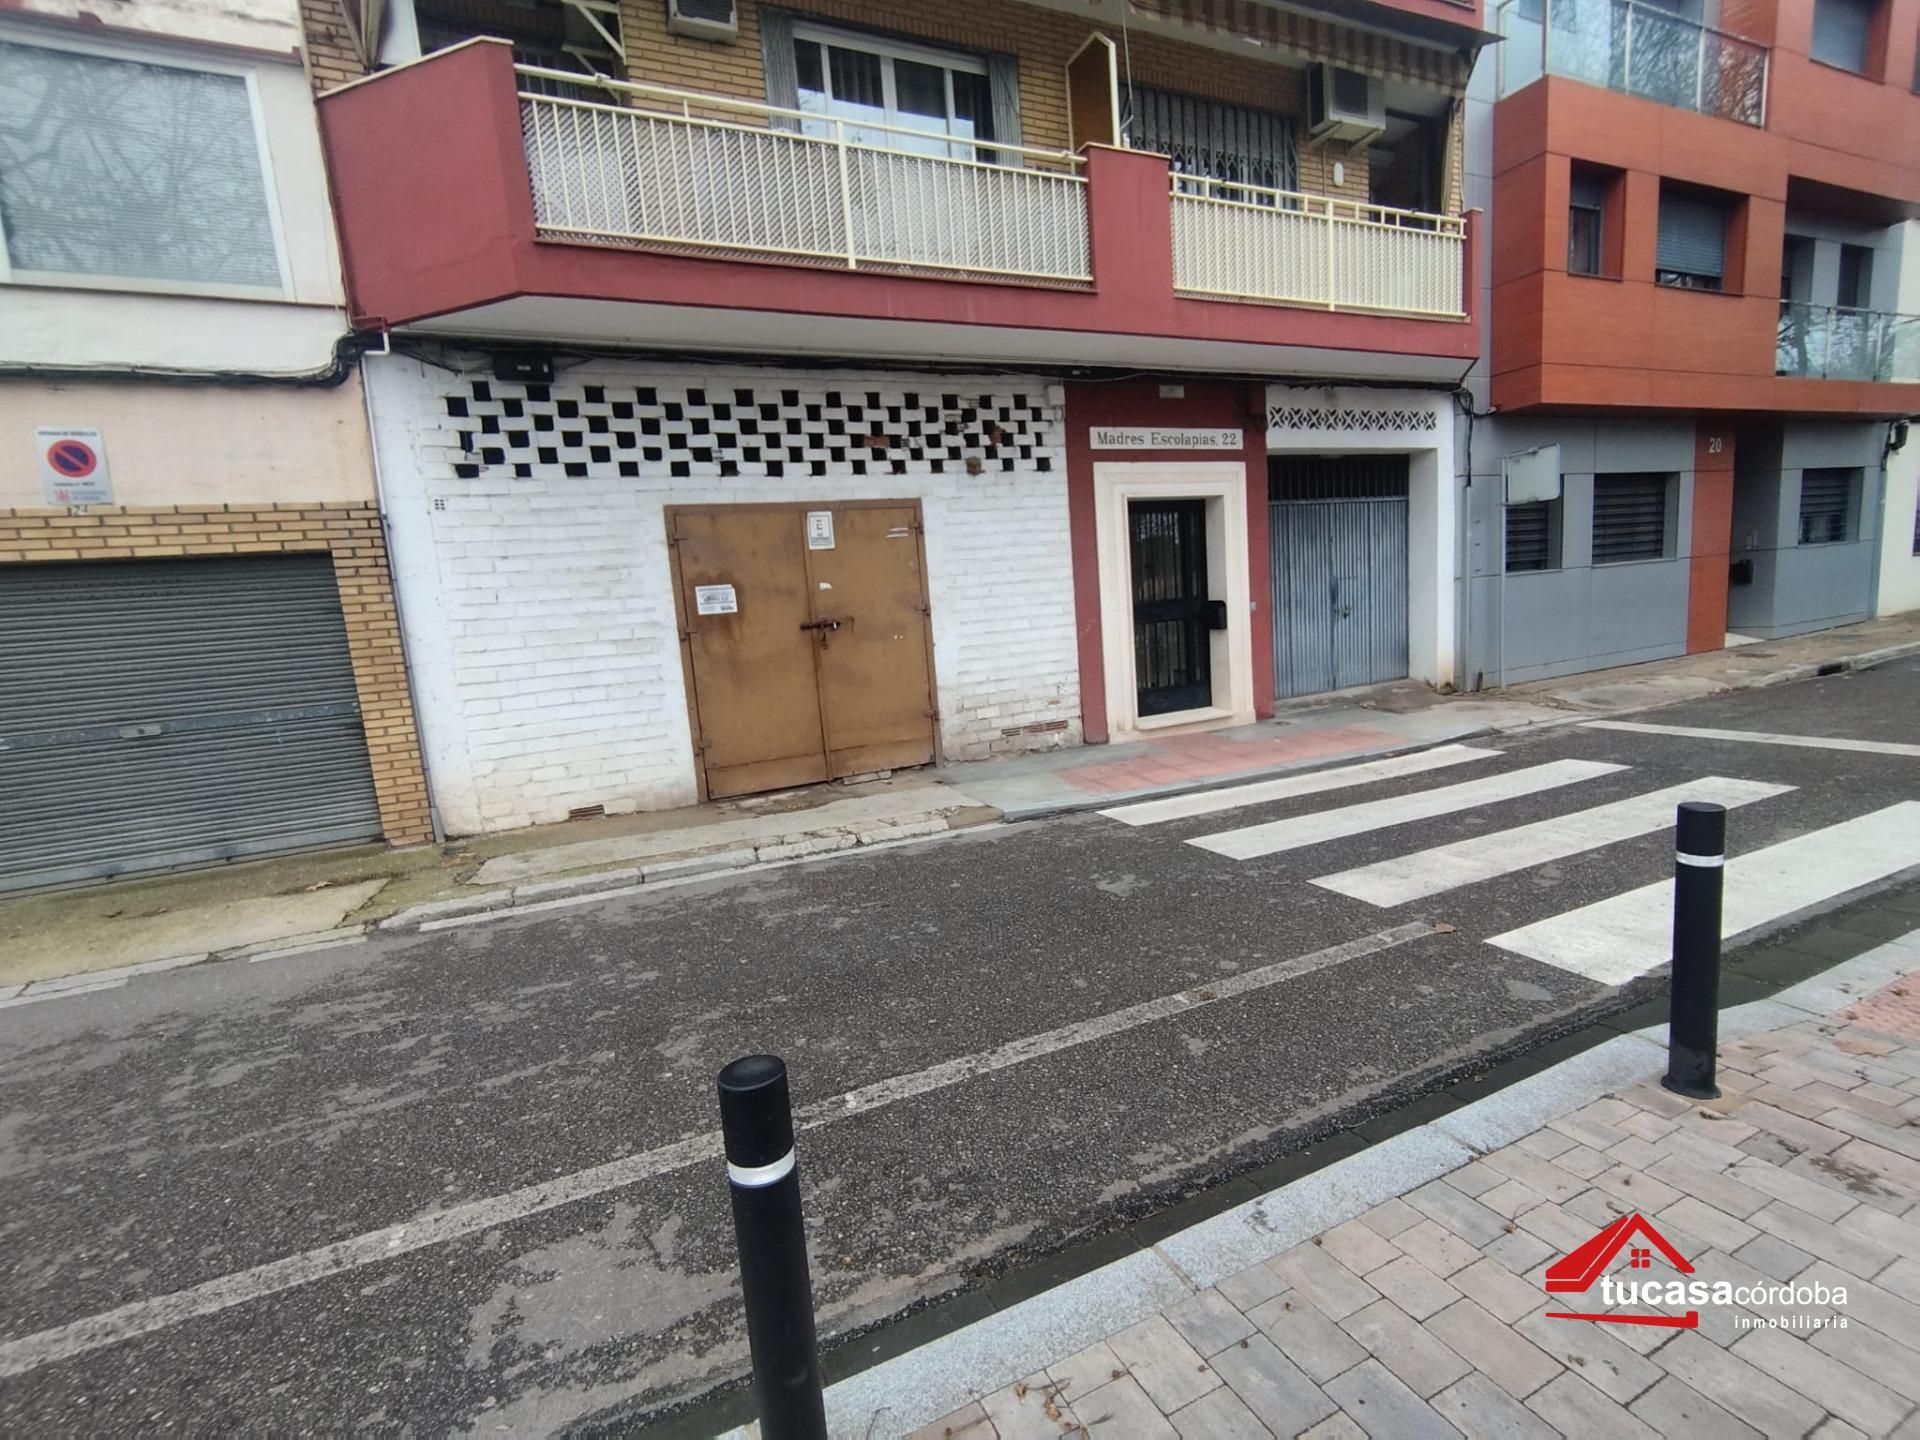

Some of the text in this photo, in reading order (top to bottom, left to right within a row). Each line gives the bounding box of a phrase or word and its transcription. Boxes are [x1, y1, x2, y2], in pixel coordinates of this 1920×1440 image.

[1097, 431, 1145, 446] Madres
[1222, 432, 1237, 446] 22
[1709, 437, 1722, 453] 20
